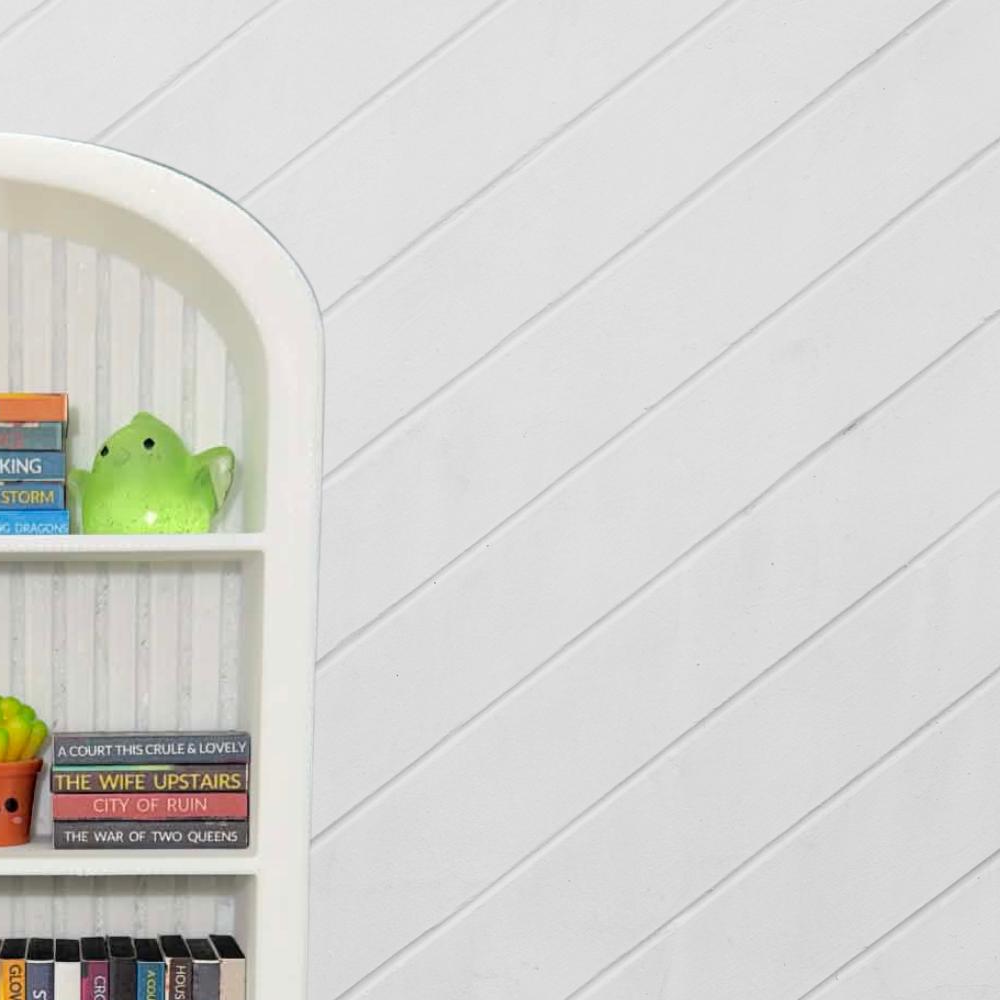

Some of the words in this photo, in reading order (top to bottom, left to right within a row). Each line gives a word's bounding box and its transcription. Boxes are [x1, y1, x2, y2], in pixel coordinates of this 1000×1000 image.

[0, 458, 42, 474] KING
[2, 490, 55, 504] STORM
[15, 522, 69, 534] DRAGONS
[57, 746, 68, 757] A
[69, 745, 113, 757] COURT
[114, 744, 143, 756] THIS
[145, 743, 185, 755] CRULE
[187, 743, 196, 754] &
[199, 741, 247, 754] LOVELY
[55, 774, 92, 790] THE
[99, 774, 146, 790] WIFE
[153, 773, 242, 790] UPSTAIRS
[93, 799, 131, 813] CITY
[136, 799, 160, 813] OF
[167, 798, 208, 812] RUIN
[64, 831, 88, 842] THE
[93, 831, 124, 842] WAR
[128, 831, 146, 842] OF
[152, 831, 183, 842] TWO
[187, 831, 238, 844] QUEENS
[147, 970, 156, 979] A
